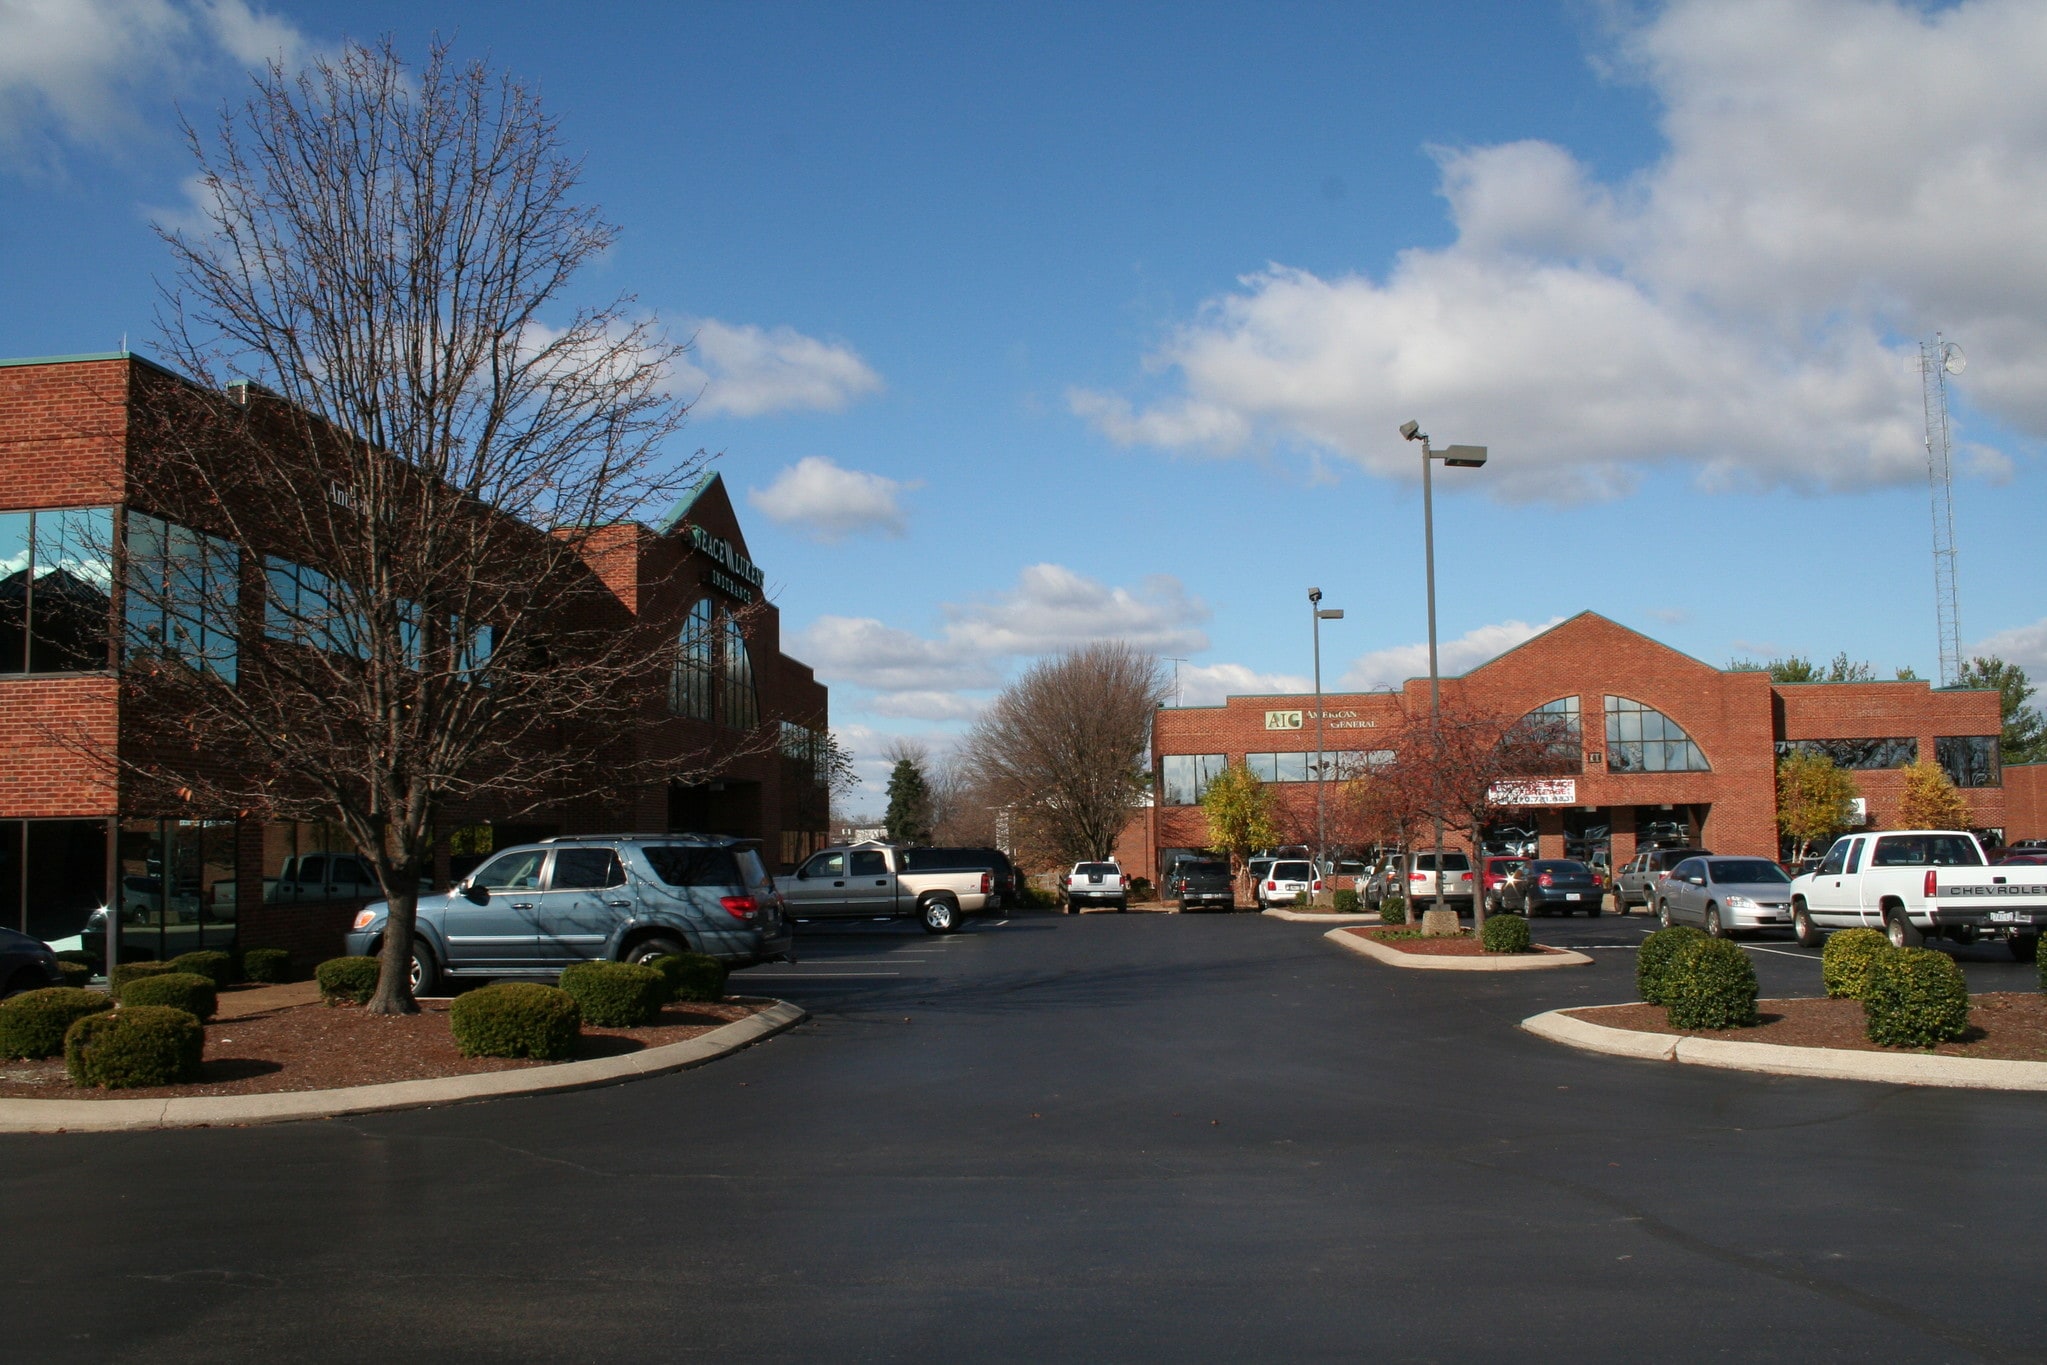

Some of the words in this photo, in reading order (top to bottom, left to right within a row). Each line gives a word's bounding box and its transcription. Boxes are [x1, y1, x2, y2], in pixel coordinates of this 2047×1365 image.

[712, 570, 752, 605] INSURANCE
[1268, 712, 1300, 728] AIG
[1950, 886, 2047, 895] CHEVROLET
